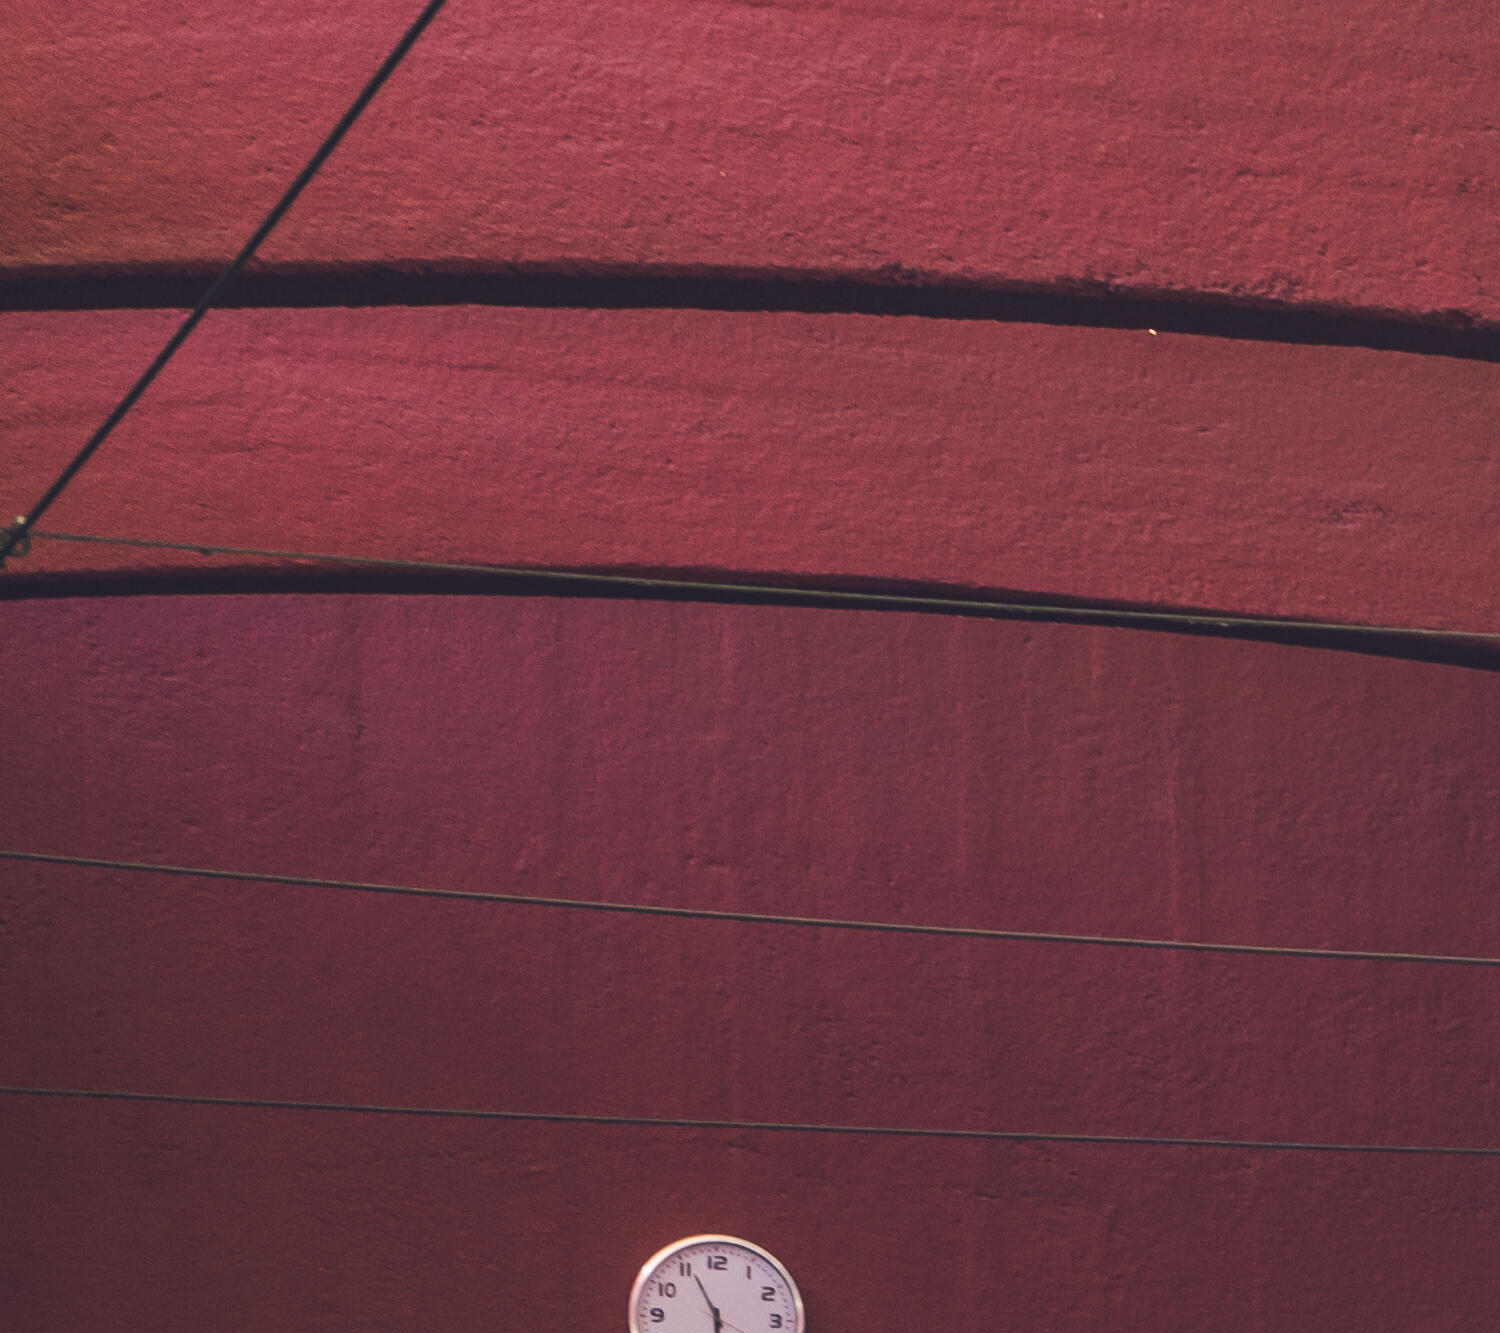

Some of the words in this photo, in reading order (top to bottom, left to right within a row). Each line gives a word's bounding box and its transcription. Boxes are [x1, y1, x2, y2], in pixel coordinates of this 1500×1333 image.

[679, 1262, 692, 1277] 11
[707, 1255, 728, 1271] 12
[746, 1265, 752, 1280] 1
[658, 1282, 677, 1298] 10
[760, 1286, 776, 1301] 2
[650, 1307, 665, 1323] 9
[769, 1313, 782, 1328] 3
